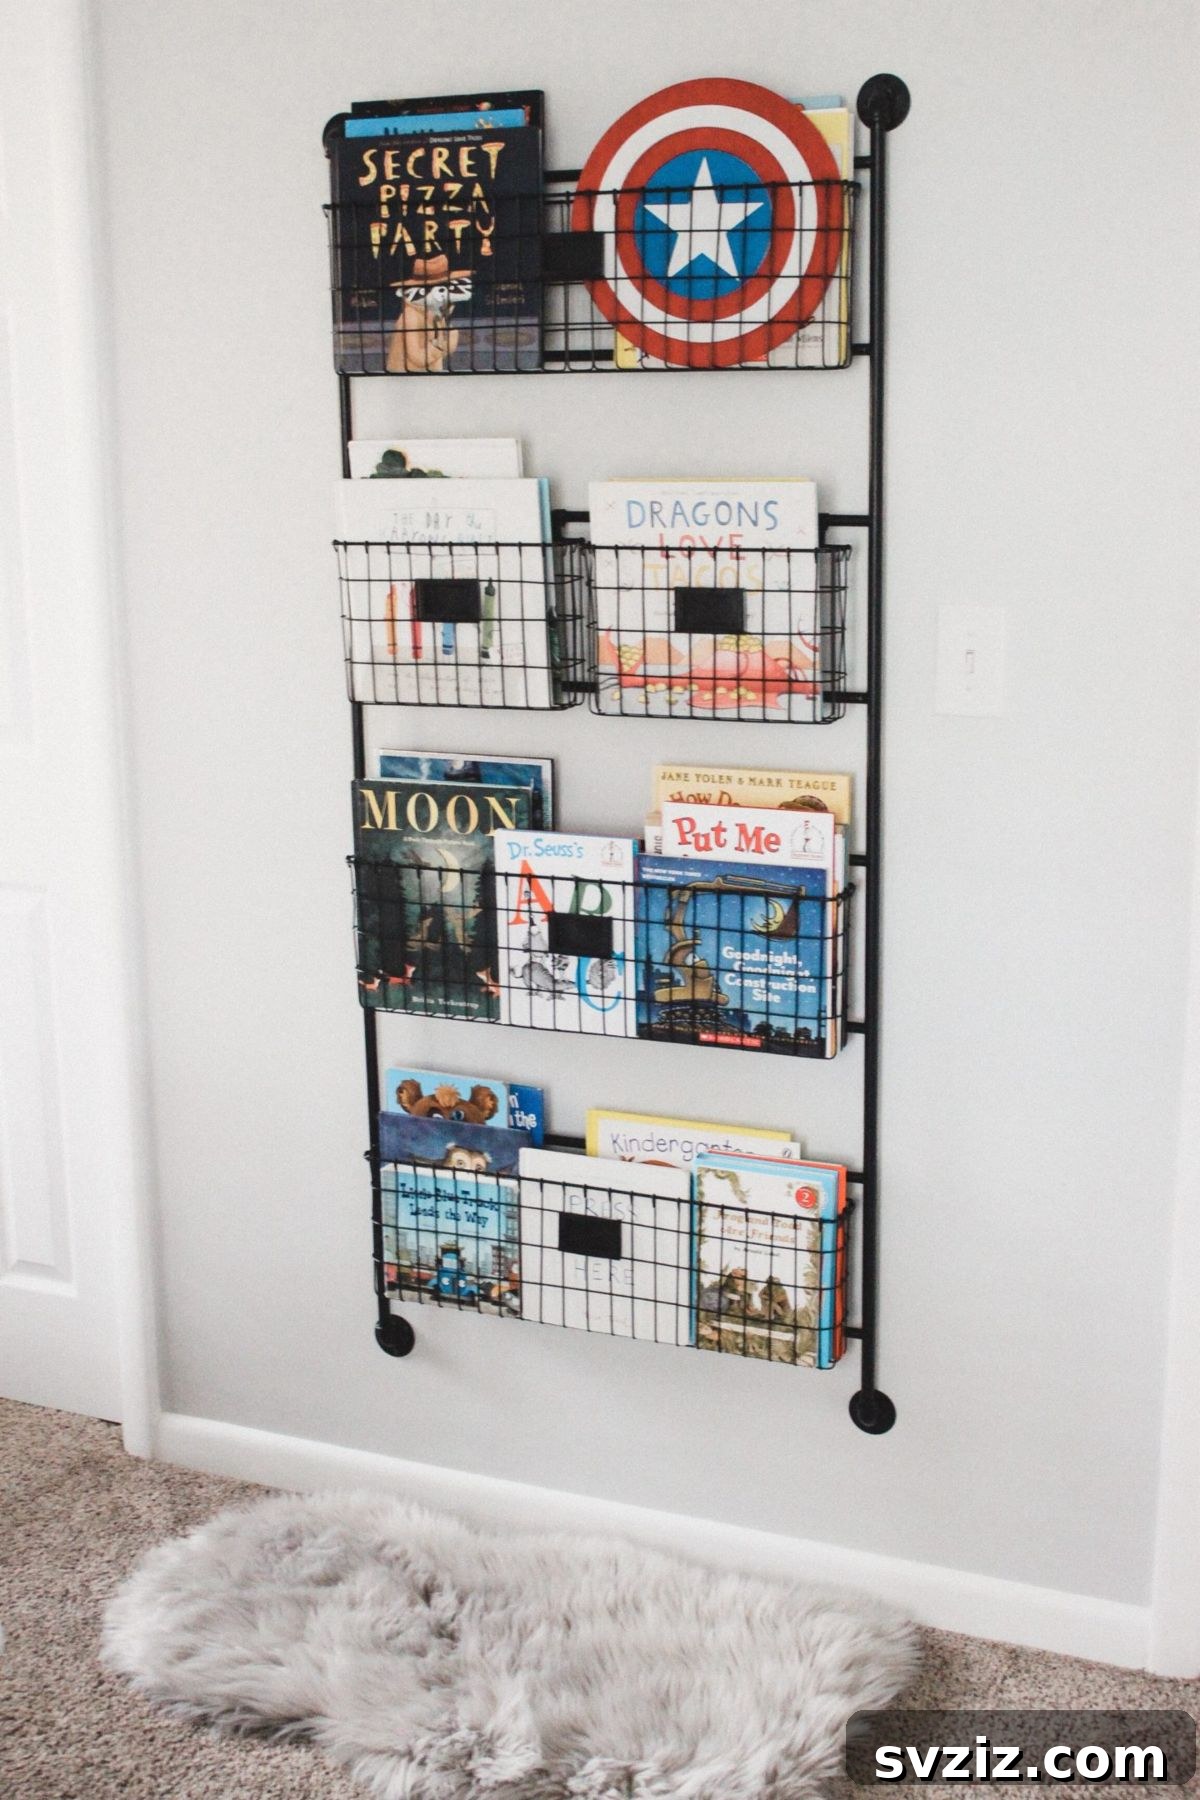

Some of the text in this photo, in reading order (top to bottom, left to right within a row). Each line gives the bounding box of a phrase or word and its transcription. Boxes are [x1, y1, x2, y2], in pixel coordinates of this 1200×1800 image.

[358, 142, 505, 187] SECRET
[380, 182, 490, 219] PIZZA
[370, 216, 495, 259] PARTY
[627, 500, 779, 531] DRAGONS
[659, 532, 747, 561] LOVE
[643, 562, 764, 597] TACOS
[661, 771, 690, 783] JANE
[749, 776, 784, 788] MARK
[789, 779, 838, 792] TEAGUE
[359, 788, 521, 838] MOON
[507, 841, 531, 860] Dr.
[672, 816, 728, 854] Put
[734, 822, 782, 855] Me
[513, 1110, 538, 1130] the
[574, 1258, 636, 1287] HERE
